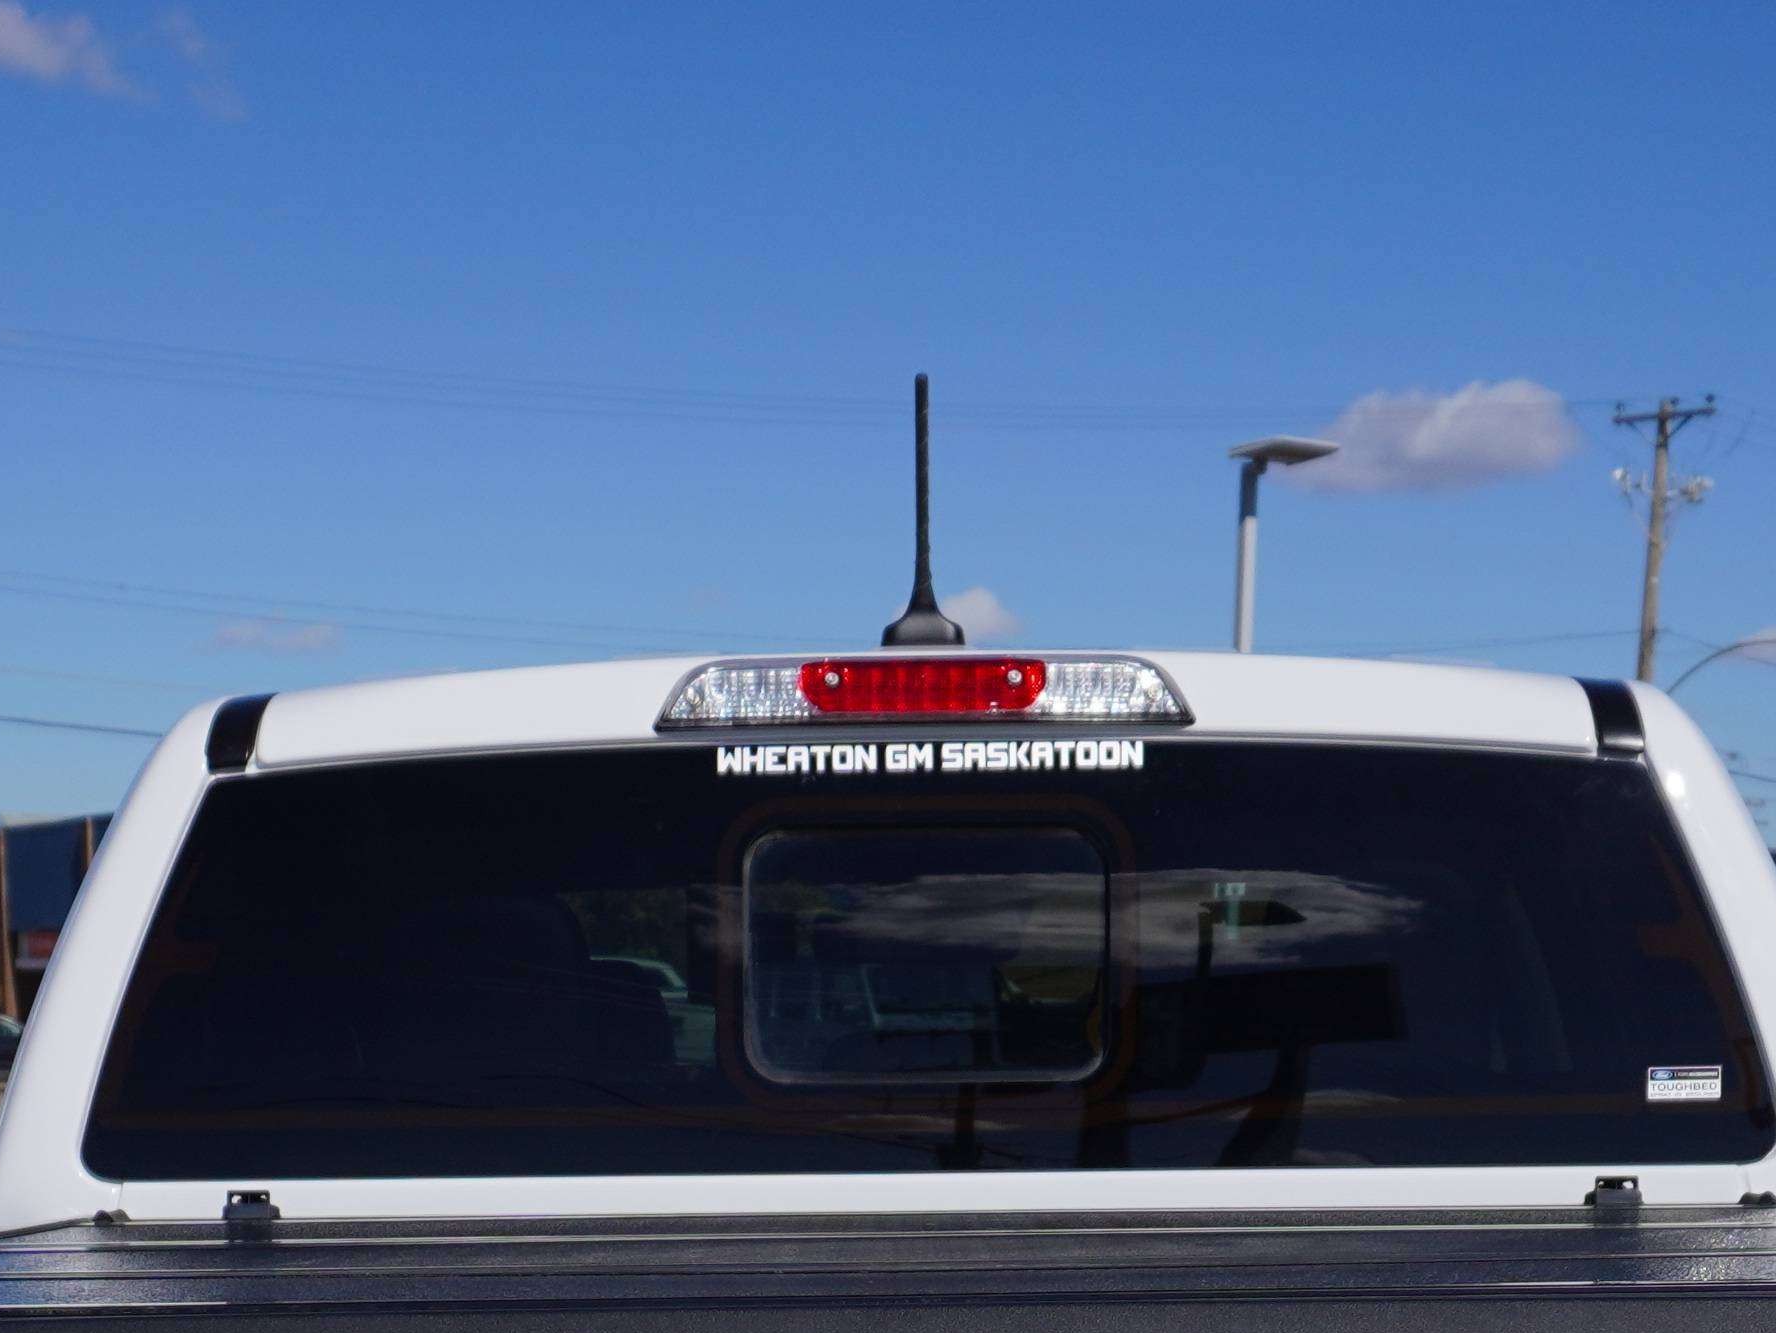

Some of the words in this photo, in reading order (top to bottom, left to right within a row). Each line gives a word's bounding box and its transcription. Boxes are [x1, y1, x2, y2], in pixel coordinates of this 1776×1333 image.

[717, 742, 877, 774] WHEATON
[885, 741, 934, 772] GM
[940, 739, 1145, 770] SASKATOON
